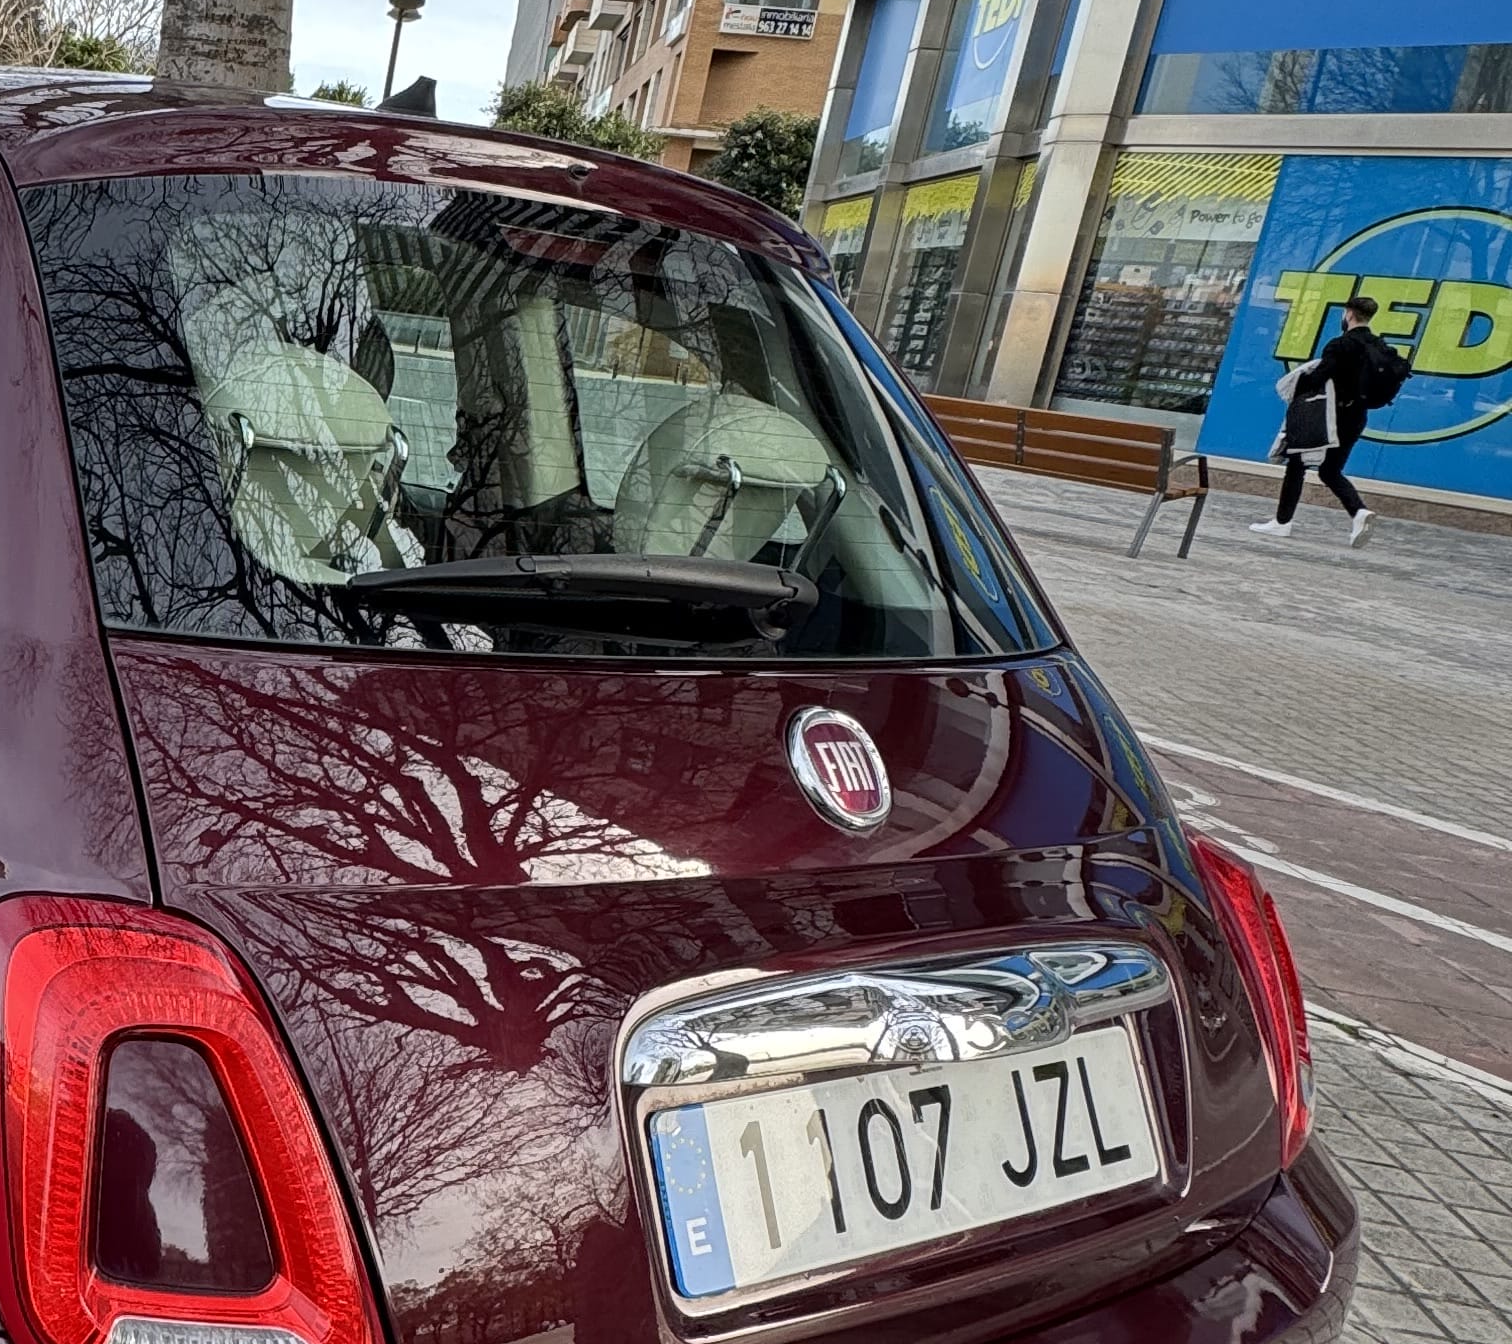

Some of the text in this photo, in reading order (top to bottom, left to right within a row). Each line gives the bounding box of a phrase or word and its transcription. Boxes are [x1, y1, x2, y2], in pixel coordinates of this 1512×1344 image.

[758, 20, 812, 36] 963 27 14 14
[760, 9, 815, 23] inmobiliaria
[1190, 208, 1263, 229] Power to go
[814, 741, 876, 793] FIAT
[739, 1056, 1132, 1250] 1107 JZL
[686, 1217, 713, 1257] E
